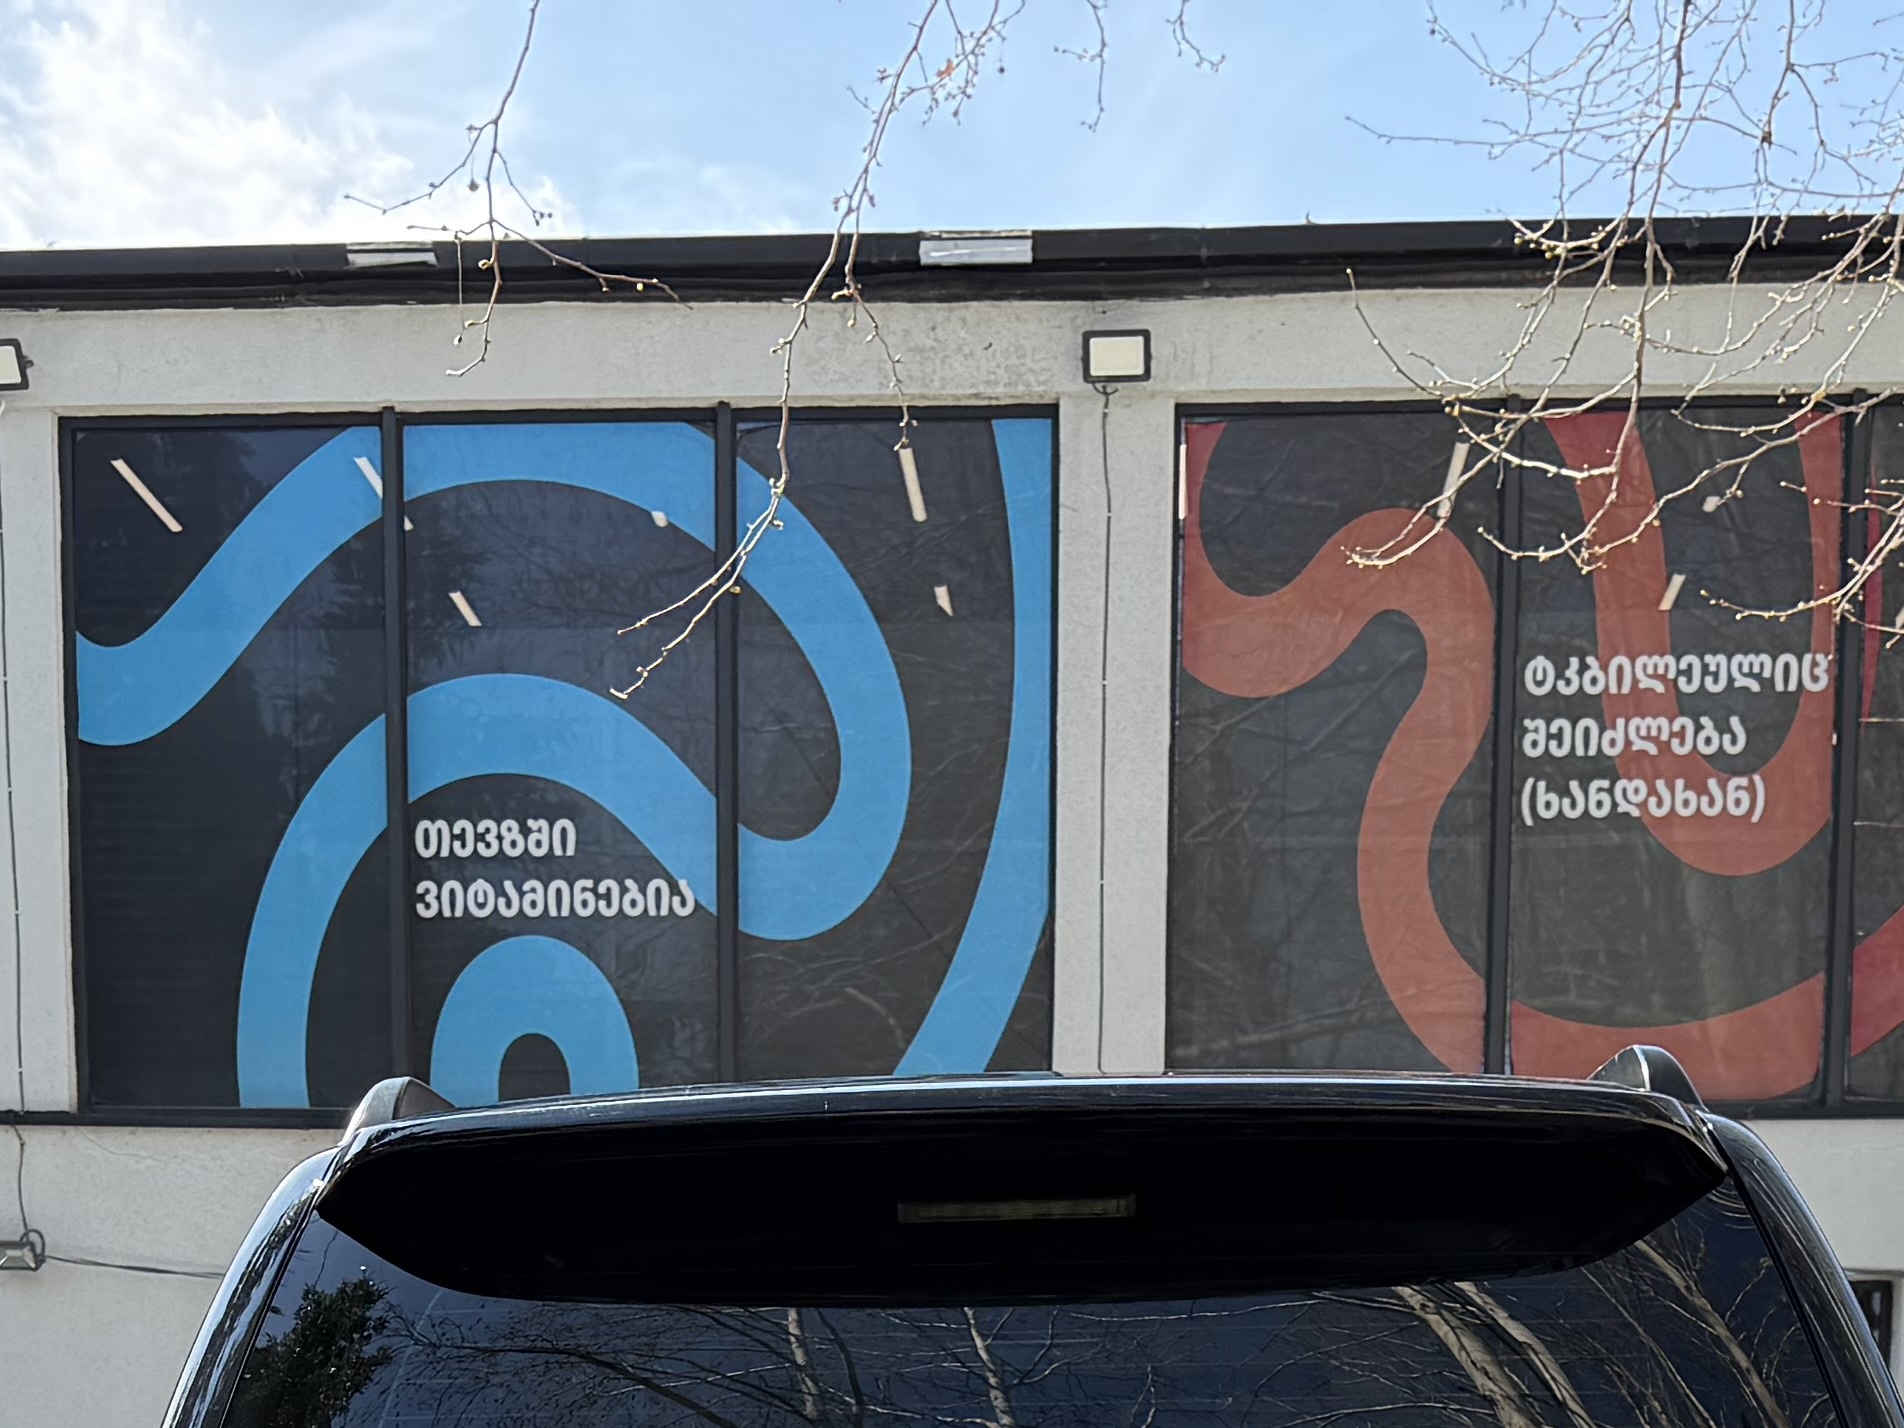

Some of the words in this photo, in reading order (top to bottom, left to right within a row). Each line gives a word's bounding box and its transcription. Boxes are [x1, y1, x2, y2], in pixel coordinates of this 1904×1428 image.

[1523, 652, 1830, 696] ტკბილეულიც
[1522, 715, 1747, 758] შეიძლება
[1520, 773, 1766, 827] (ხანდახან)
[414, 818, 577, 859] თევზში
[415, 878, 696, 919] ვიტამინებია
